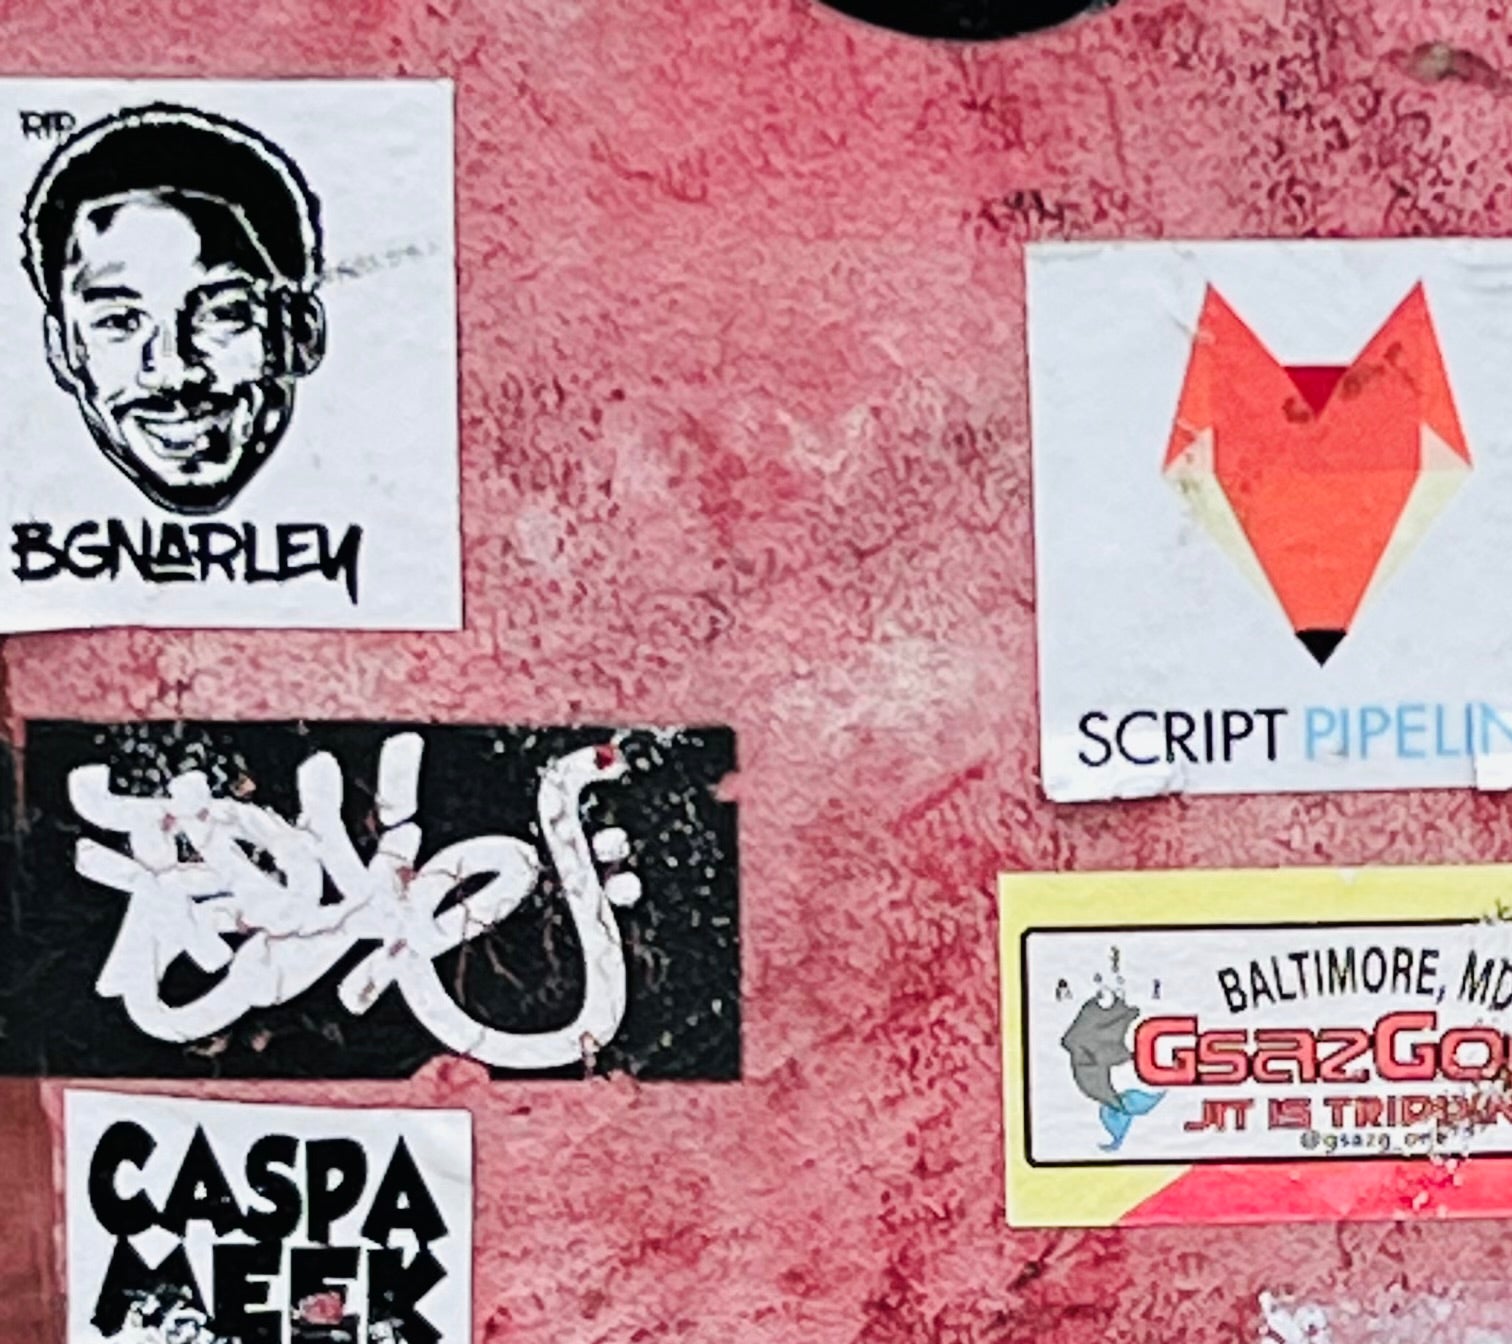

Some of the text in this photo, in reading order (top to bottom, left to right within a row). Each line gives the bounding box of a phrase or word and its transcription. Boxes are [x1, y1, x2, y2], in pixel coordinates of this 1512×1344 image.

[1078, 707, 1288, 767] SCRIPT
[1217, 945, 1447, 1014] BALTIMORE,
[1267, 1097, 1312, 1131] IS
[87, 1119, 451, 1248] CASPA
